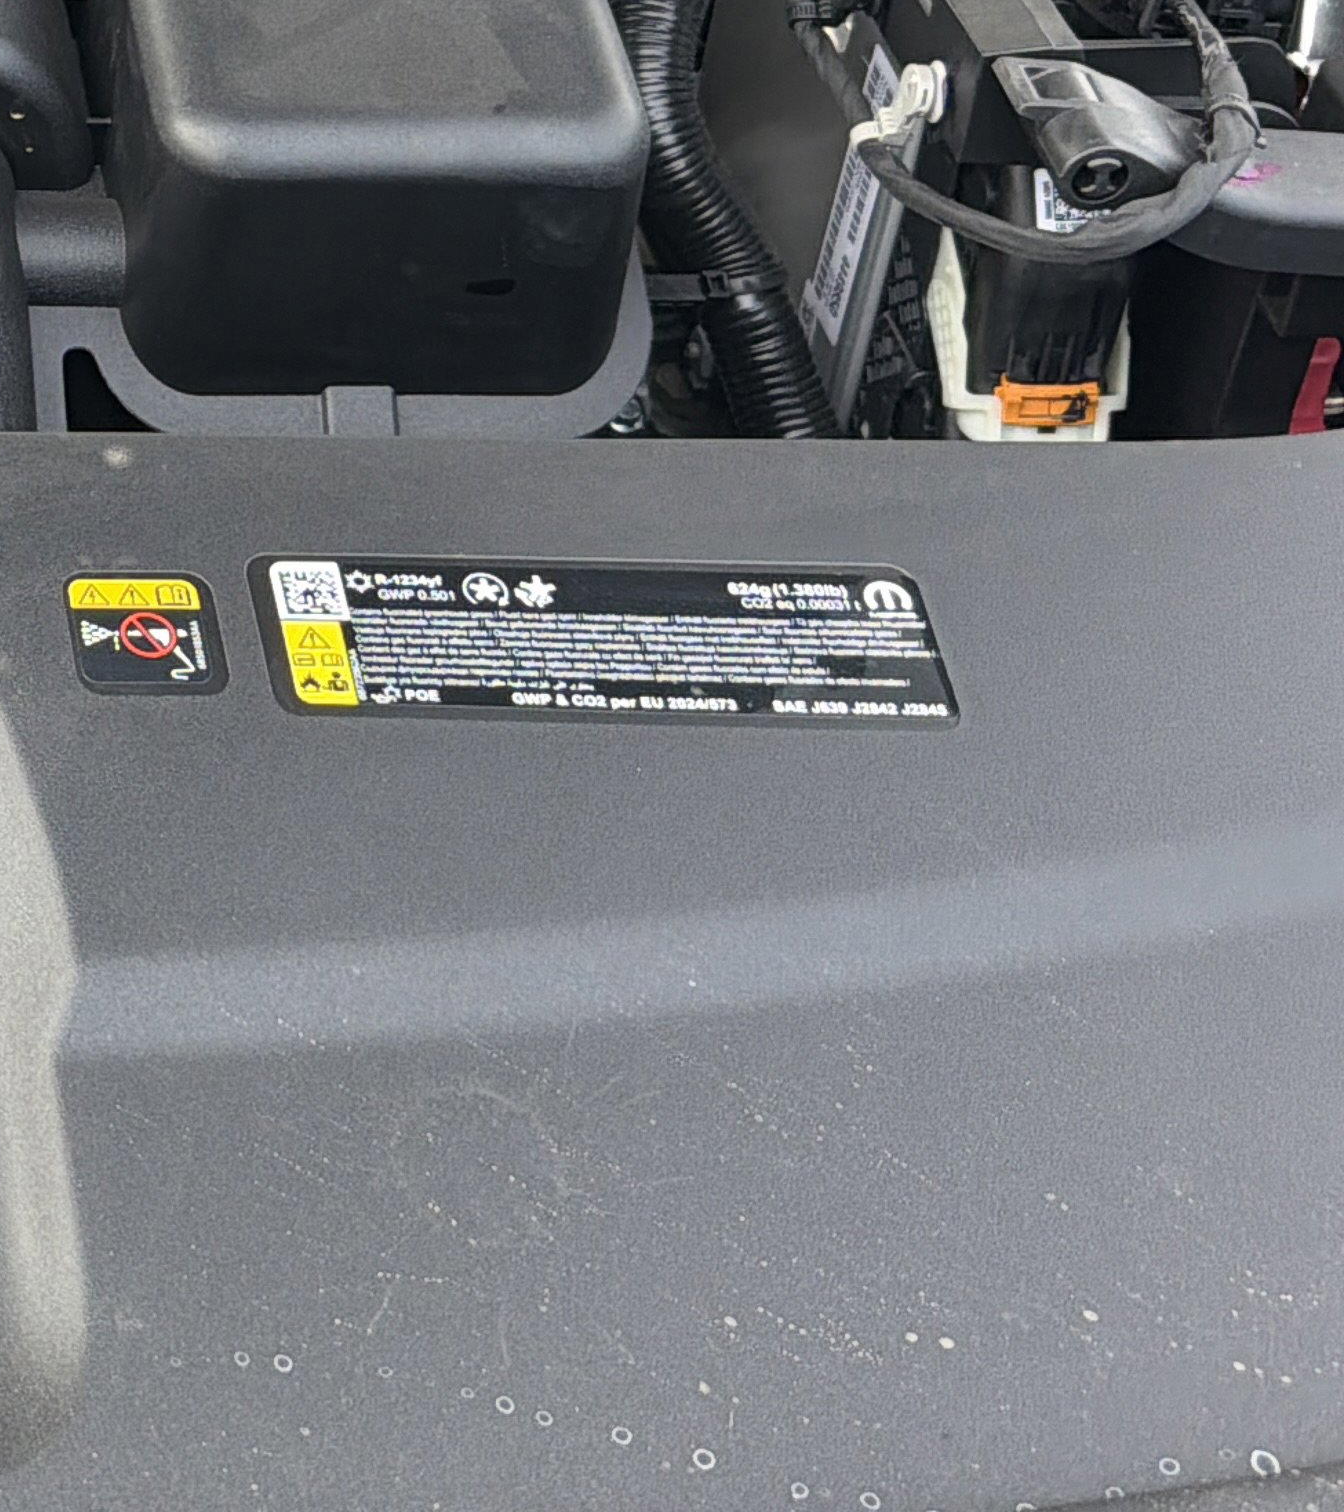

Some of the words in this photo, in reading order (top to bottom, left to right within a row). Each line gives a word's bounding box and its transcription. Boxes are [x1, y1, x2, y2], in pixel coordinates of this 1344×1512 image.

[403, 688, 441, 703] POE
[511, 691, 552, 706] GWP
[555, 692, 571, 707] &
[572, 693, 607, 708] CO2
[609, 697, 636, 712] per
[639, 695, 665, 709] EU
[772, 699, 808, 714] SAE
